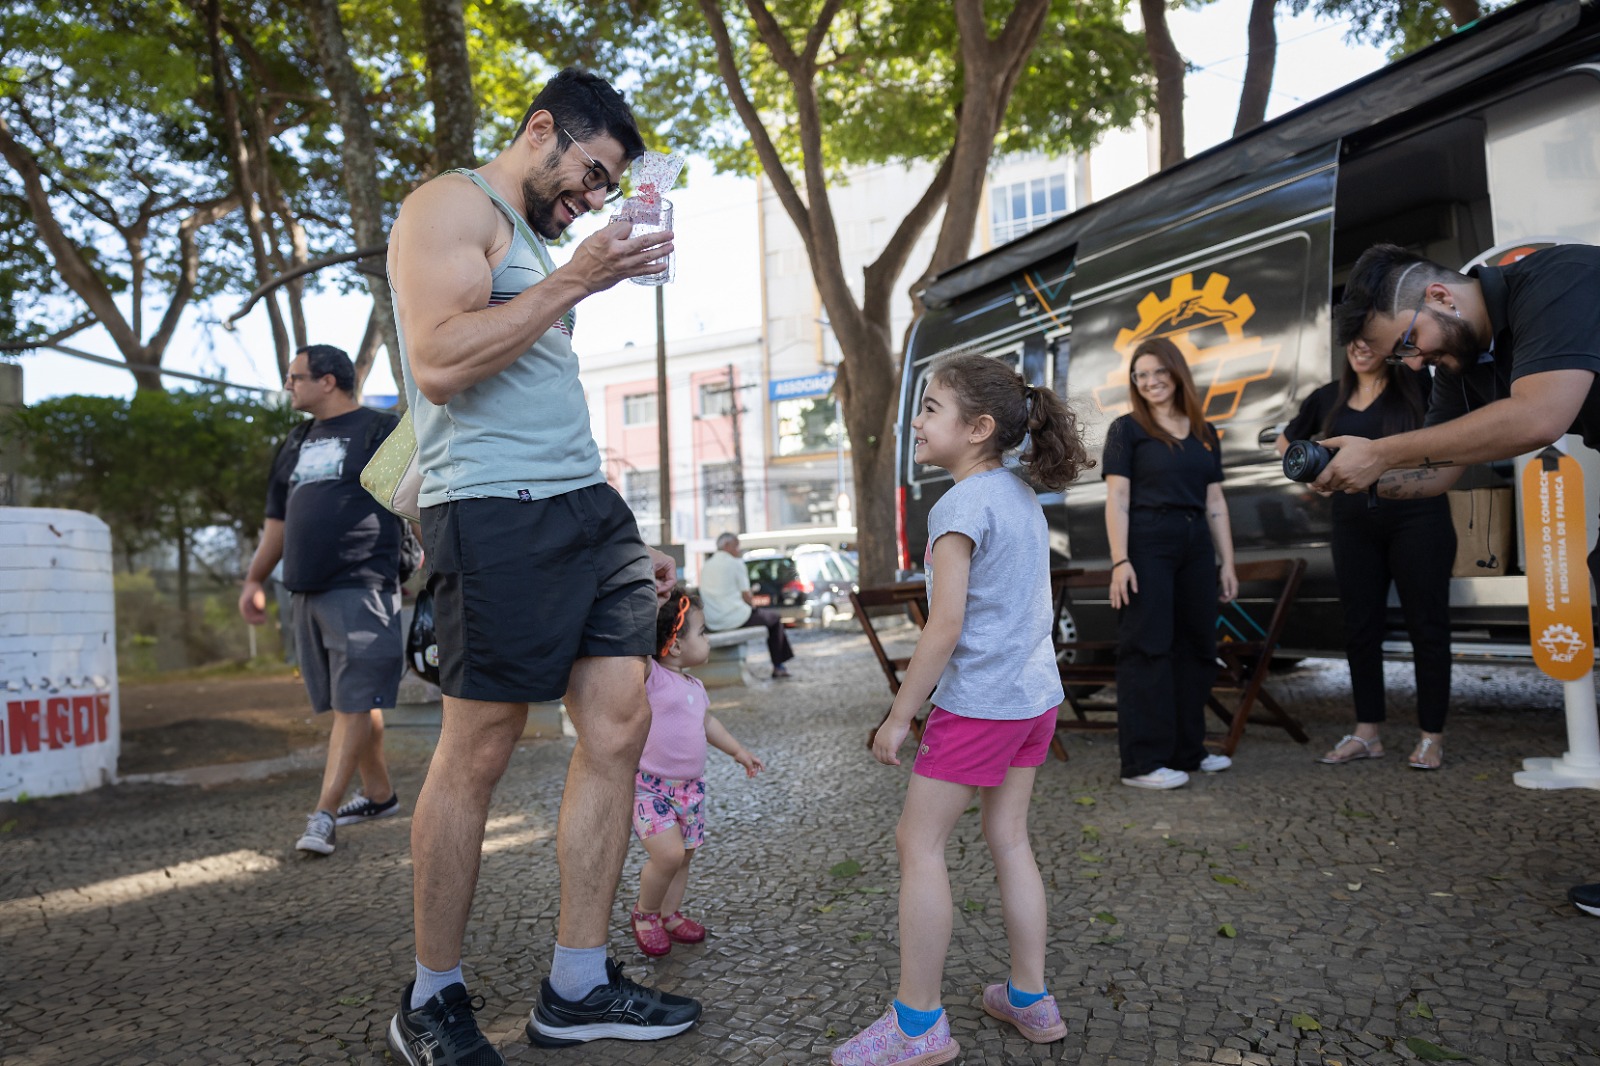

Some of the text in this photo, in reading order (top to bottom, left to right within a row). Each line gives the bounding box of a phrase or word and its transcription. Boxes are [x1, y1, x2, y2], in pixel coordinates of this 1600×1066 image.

[1555, 475, 1565, 519] FRANCA
[1542, 526, 1551, 542] DO
[1556, 521, 1566, 535] DE
[1542, 544, 1556, 612] ASSOCIAÇÃO
[1558, 538, 1569, 594] INDÚSTRIA
[1551, 653, 1574, 663] ACIF
